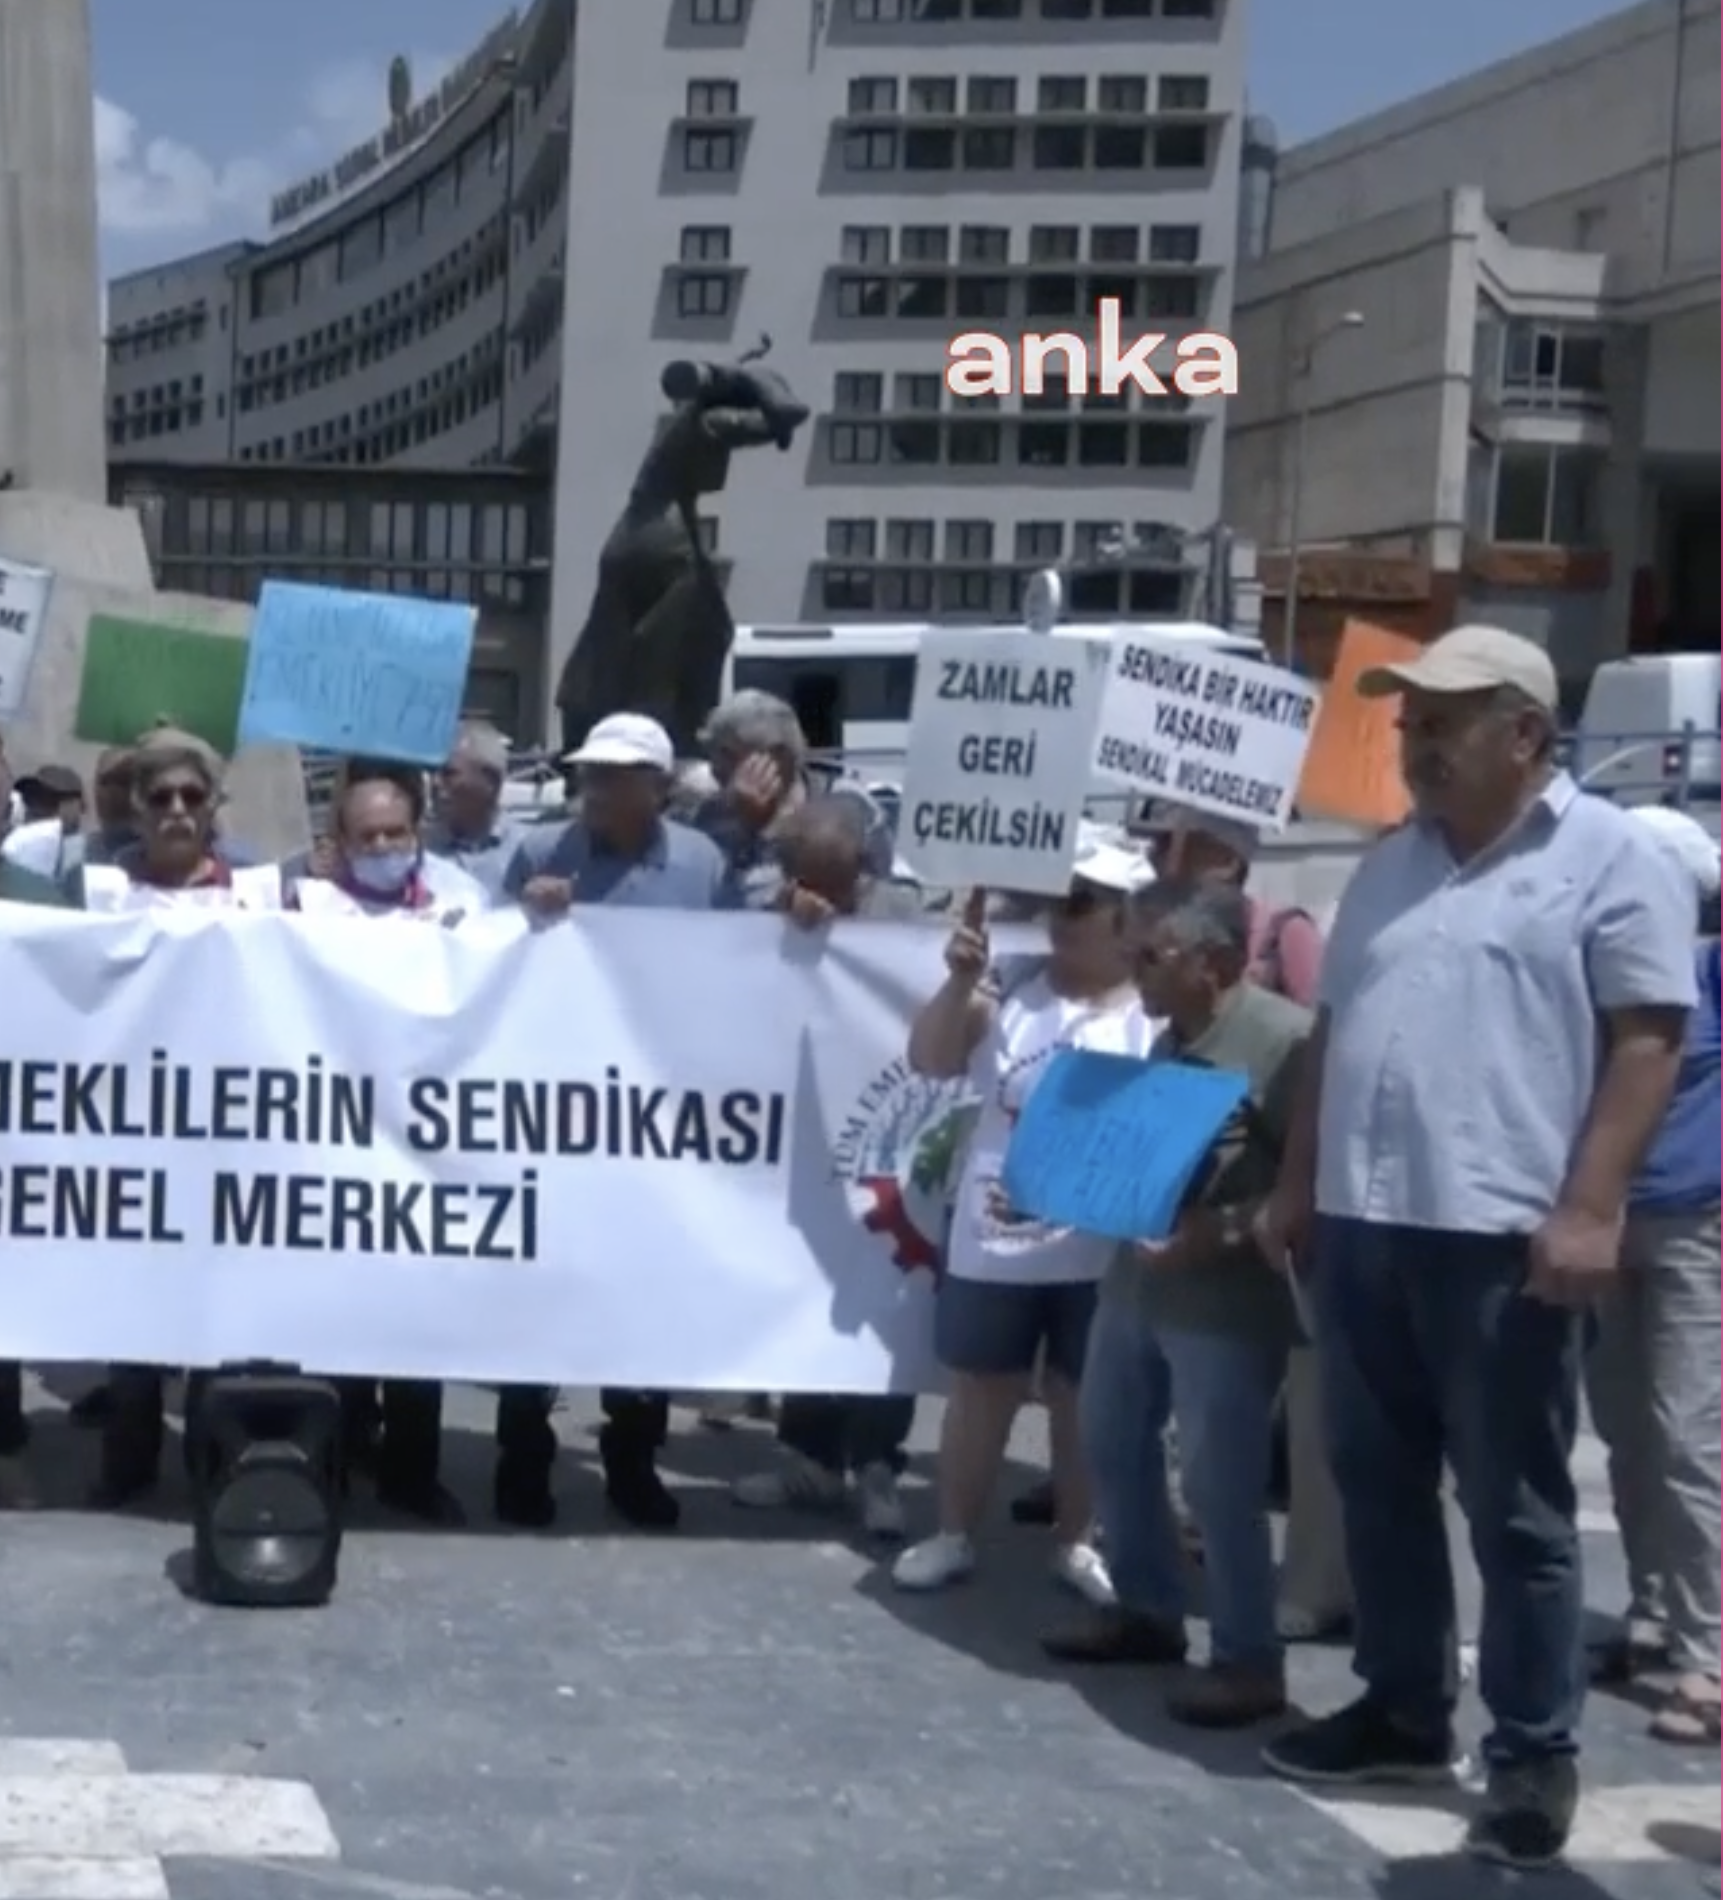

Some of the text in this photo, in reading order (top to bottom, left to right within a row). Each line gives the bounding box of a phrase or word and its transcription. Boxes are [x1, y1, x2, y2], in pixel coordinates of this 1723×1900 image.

[936, 659, 1074, 708] ZAMLAR
[1117, 643, 1315, 731] SENDİKA BİR HAKTIR
[958, 729, 1037, 777] GERİ
[1154, 700, 1243, 757] YAŞASIN
[1097, 733, 1169, 786] SENDİKAL
[913, 796, 1065, 852] ÇEKİLSİN
[406, 1065, 785, 1165] SENDİKASI
[212, 1167, 539, 1261] MERKEZİ
